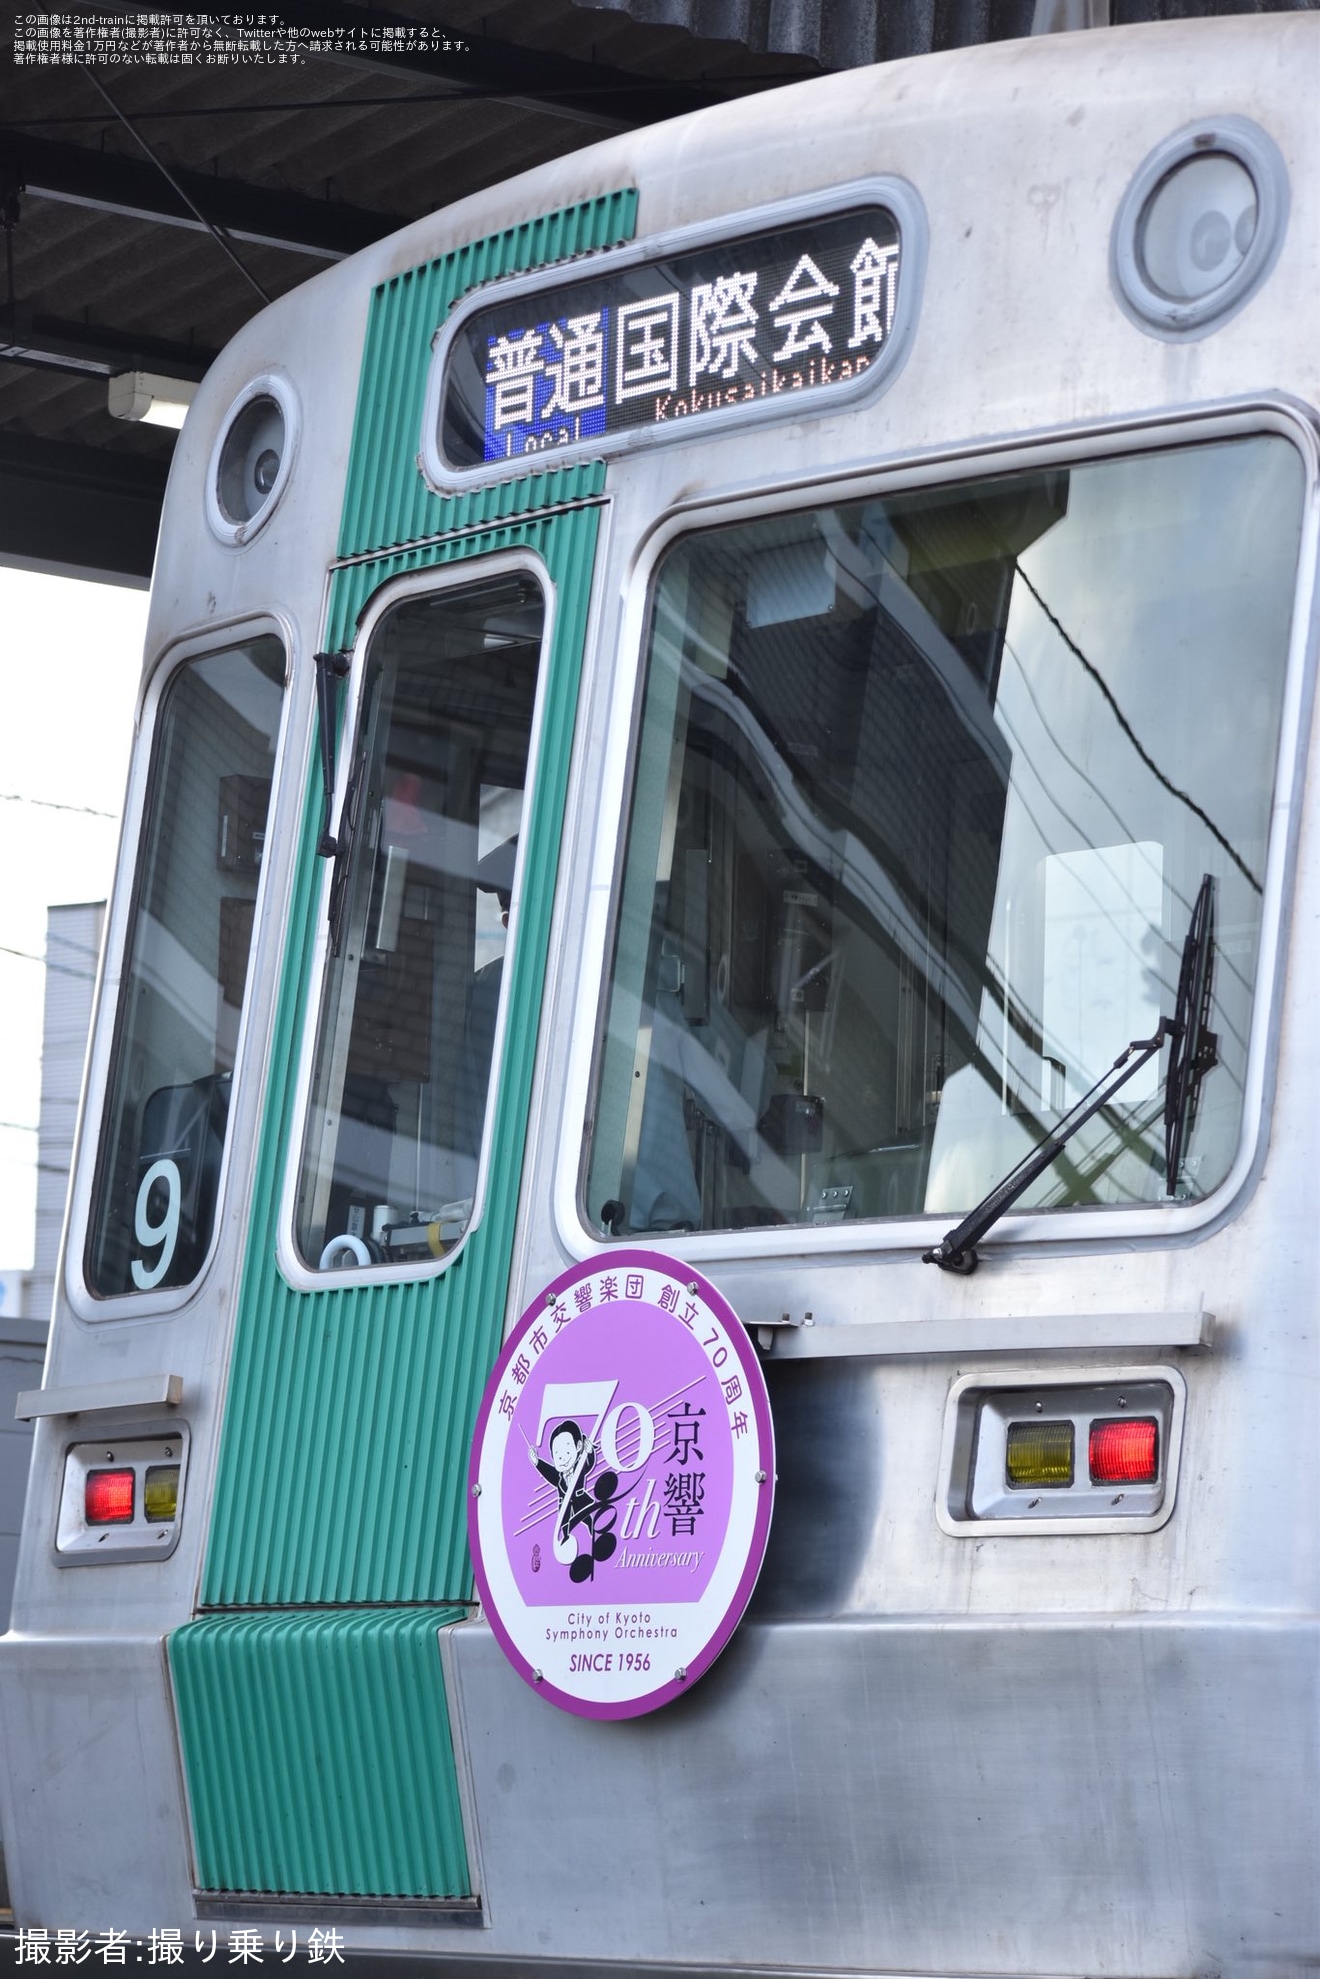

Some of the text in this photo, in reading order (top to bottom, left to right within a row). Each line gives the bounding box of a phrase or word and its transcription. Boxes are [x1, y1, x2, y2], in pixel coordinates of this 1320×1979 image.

[486, 237, 900, 430] 普通 国際会館
[130, 1158, 182, 1291] 9
[498, 1273, 749, 1440] 京都市交響楽団 創立70周年
[663, 1402, 706, 1537] 京響
[614, 1546, 705, 1573] Anniversary
[545, 1626, 678, 1643] Symphony Orchestra
[567, 1611, 652, 1627] City of Kyoto
[569, 1653, 651, 1672] SINCE 1956
